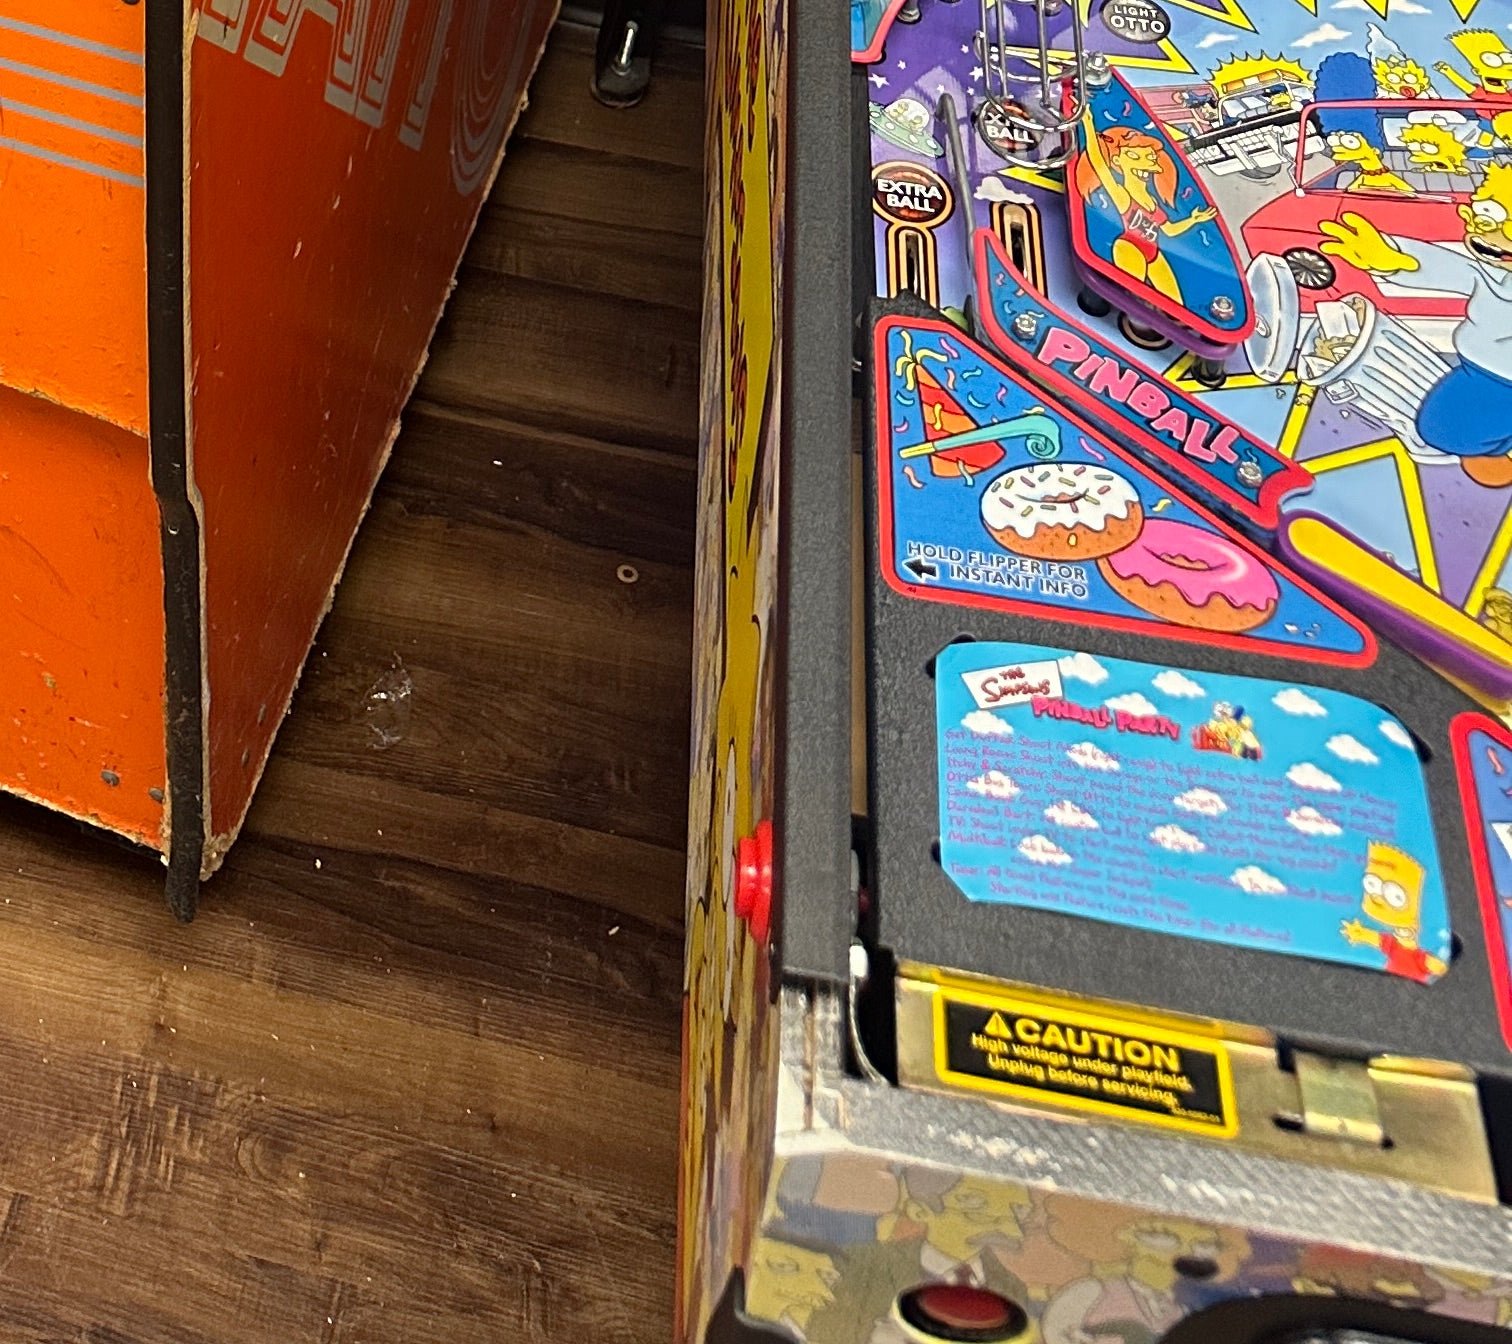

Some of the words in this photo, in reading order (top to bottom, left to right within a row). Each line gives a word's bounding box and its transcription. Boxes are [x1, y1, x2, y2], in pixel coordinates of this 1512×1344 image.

[1110, 15, 1165, 35] OTTO
[1114, 4, 1159, 19] LIGHT
[986, 125, 1035, 144] BALL
[876, 177, 943, 201] EXTRA
[886, 192, 936, 213] BALL
[1036, 326, 1241, 465] PINBALL
[907, 540, 963, 563] HOLD
[966, 549, 1043, 575] FLIPPER
[1046, 561, 1087, 582] FOR
[950, 564, 1037, 592] INSTANT
[1038, 578, 1088, 598] INFO
[1030, 693, 1114, 729] PINBALL
[1113, 708, 1181, 741] PARTY
[970, 1032, 1009, 1054] High
[1011, 1042, 1069, 1068] voltage
[1072, 1055, 1119, 1075] under
[1121, 1064, 1195, 1093] playfield.
[1014, 1017, 1182, 1074] CAUTION
[987, 1052, 1046, 1083] Unplug
[1047, 1066, 1100, 1091] before
[1101, 1076, 1180, 1110] servicing.
